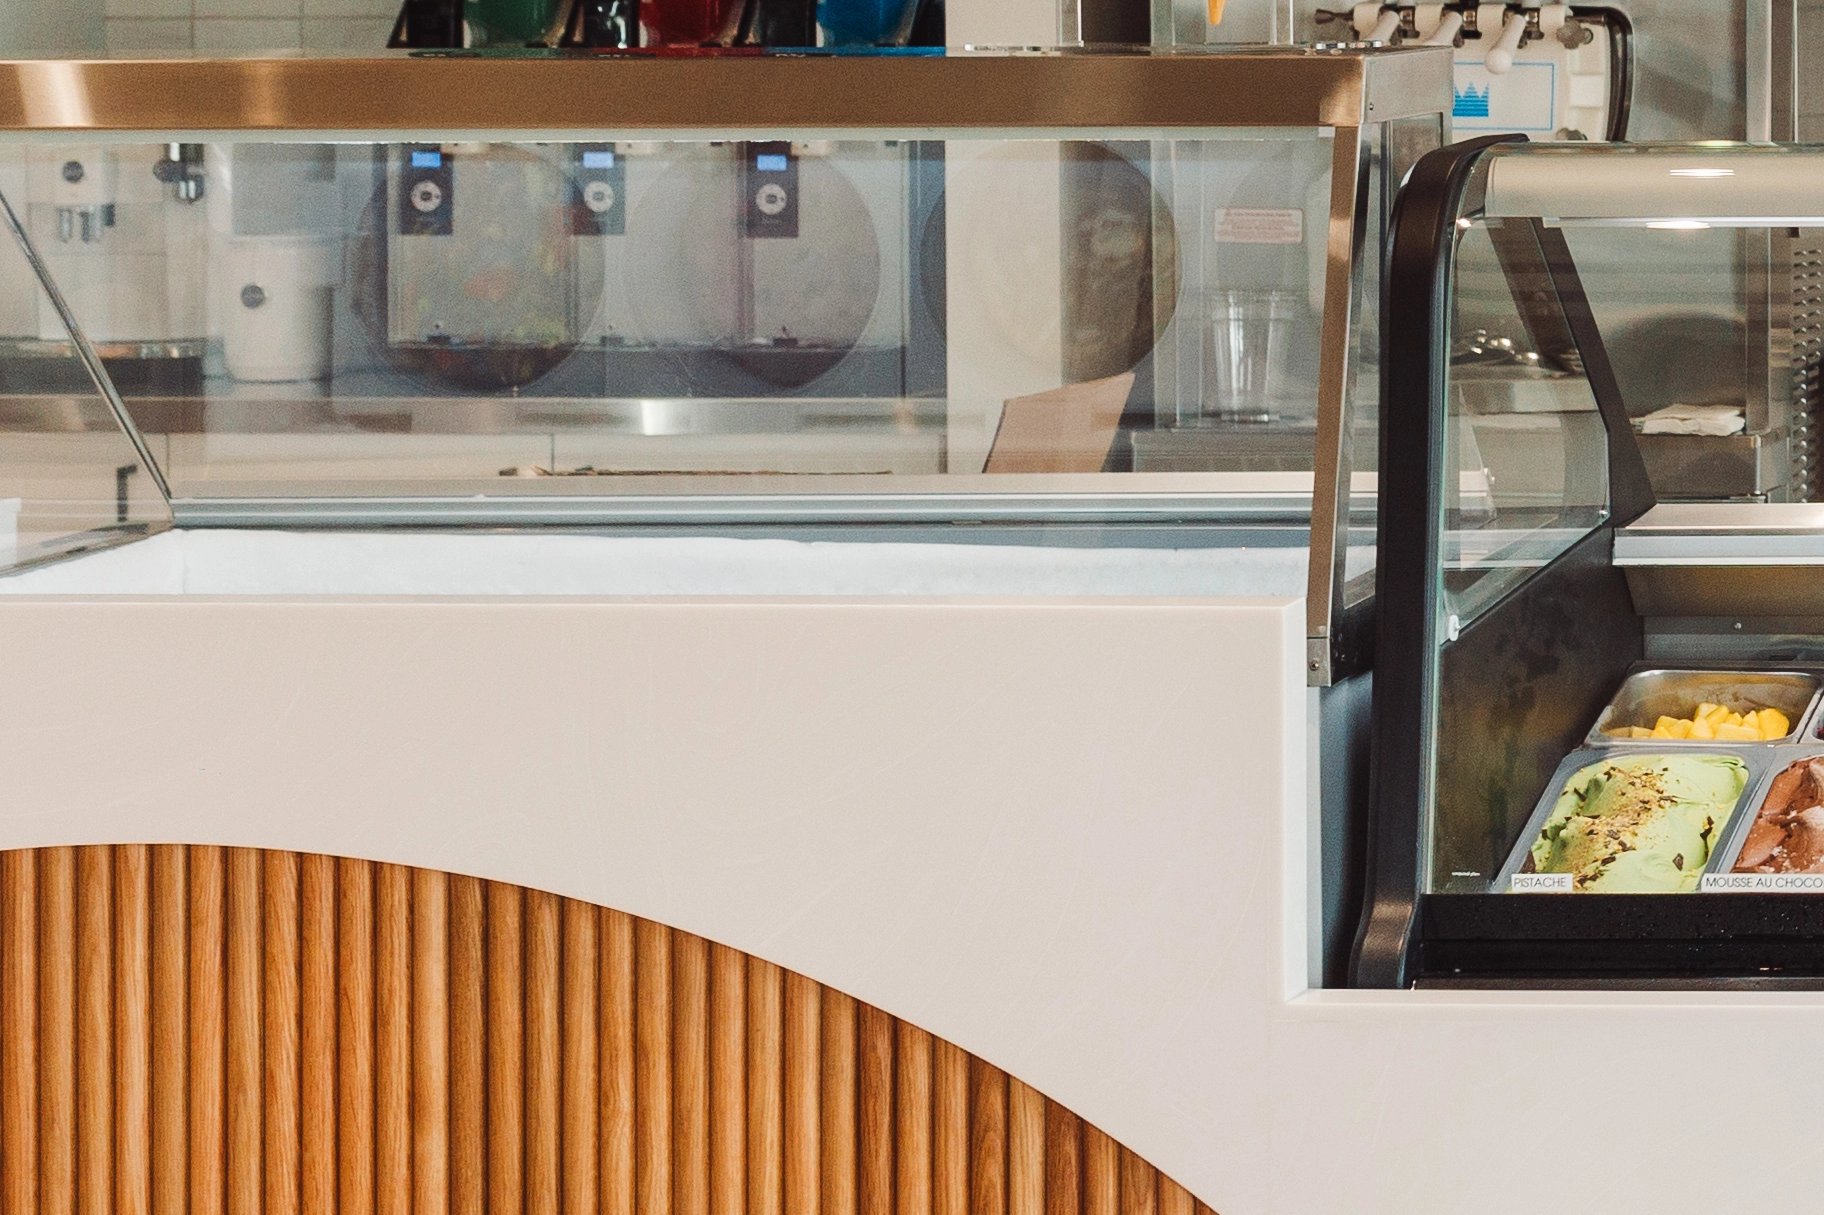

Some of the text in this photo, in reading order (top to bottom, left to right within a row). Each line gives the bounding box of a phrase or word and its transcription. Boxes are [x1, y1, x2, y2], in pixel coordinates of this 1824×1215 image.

[1514, 877, 1567, 888] PISTACHE
[1706, 877, 1752, 888] MOUSSE
[1756, 877, 1772, 888] AU
